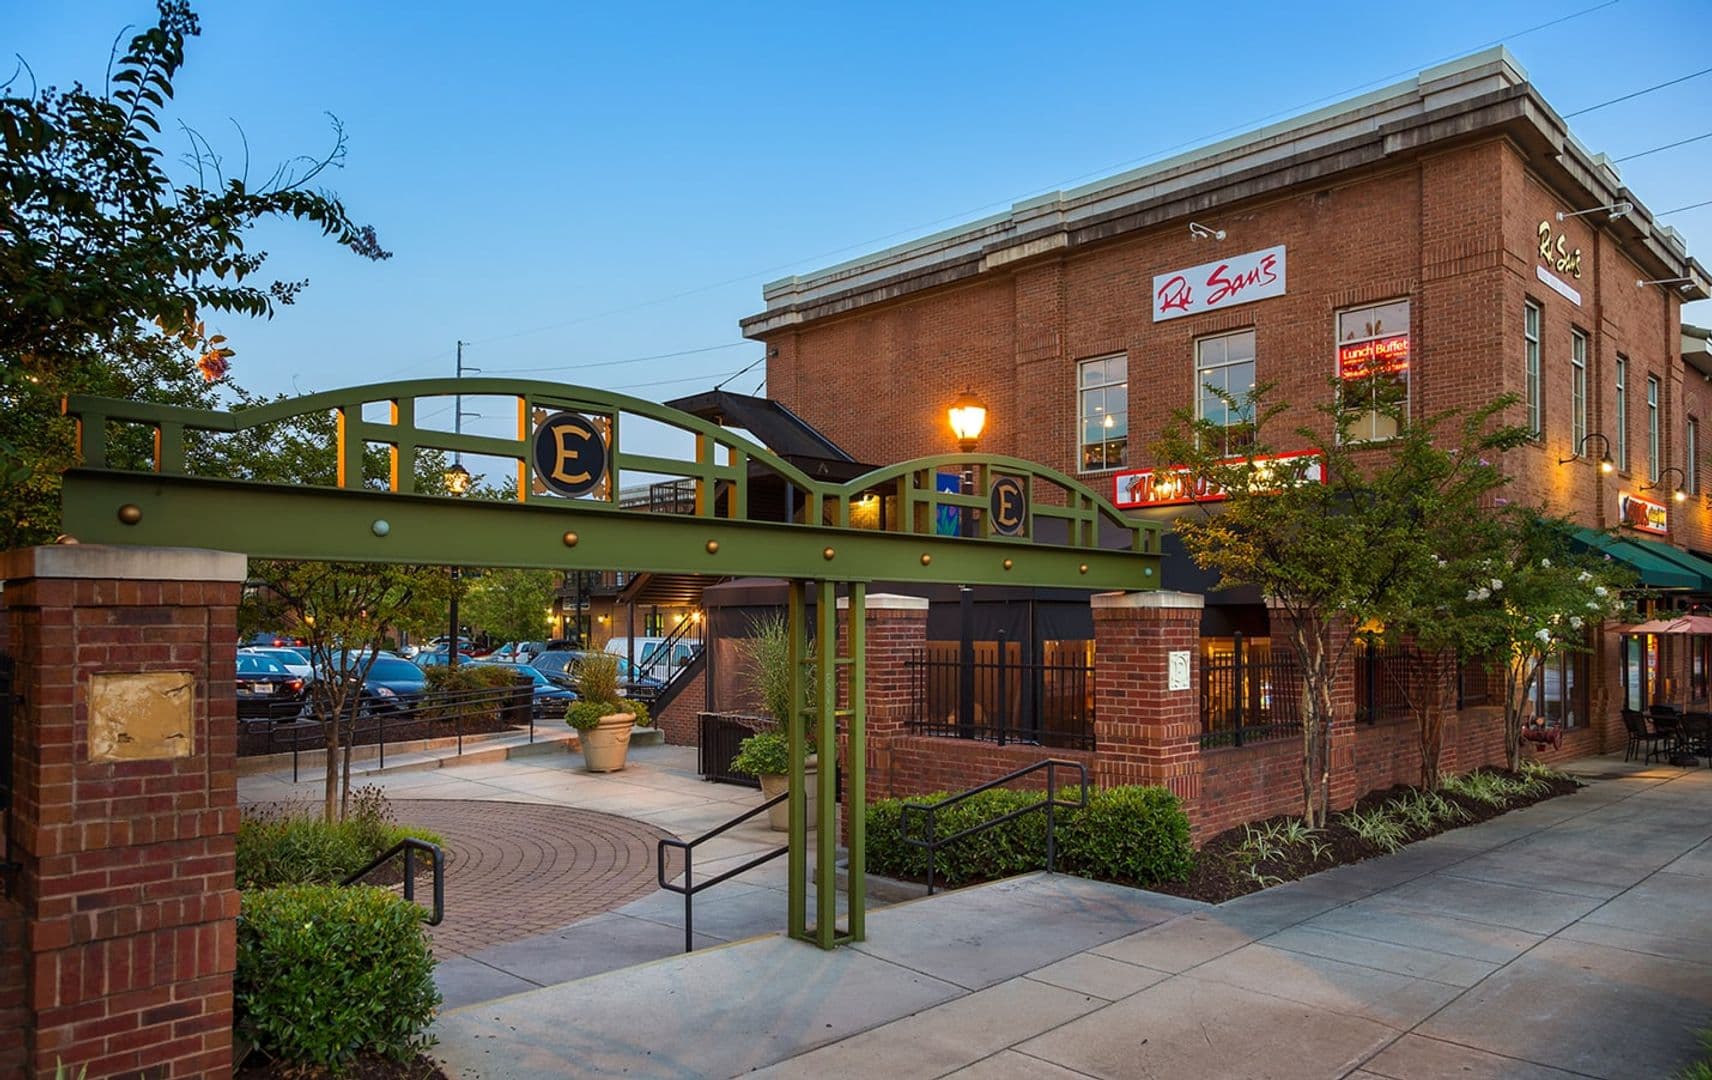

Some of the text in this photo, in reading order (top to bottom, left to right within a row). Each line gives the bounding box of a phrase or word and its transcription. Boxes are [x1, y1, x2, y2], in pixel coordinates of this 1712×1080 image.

[1343, 345, 1373, 361] Lunch
[1375, 339, 1408, 356] Buffet
[550, 424, 592, 484] E
[998, 484, 1018, 527] E
